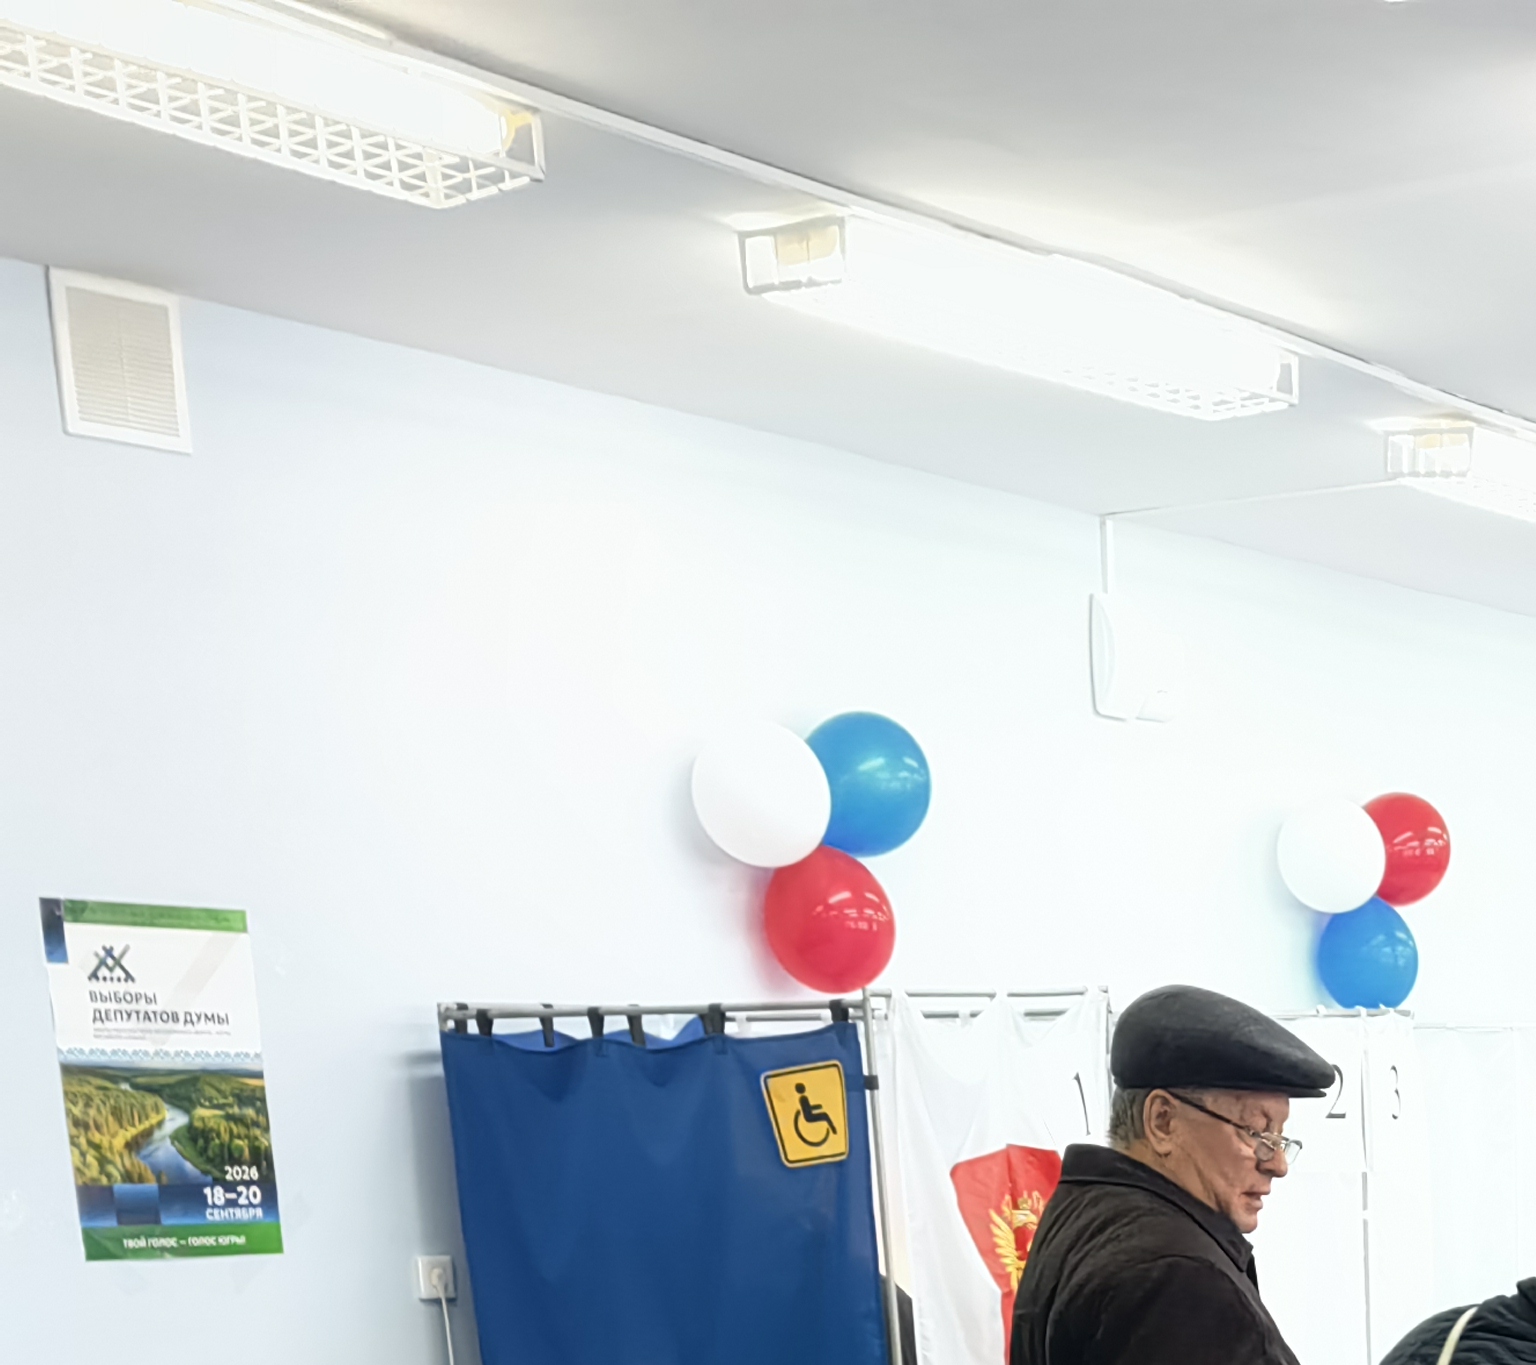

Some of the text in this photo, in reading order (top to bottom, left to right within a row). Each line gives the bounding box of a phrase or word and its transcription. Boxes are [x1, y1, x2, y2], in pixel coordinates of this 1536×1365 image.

[89, 990, 157, 1005] ВЫБОРЫ
[92, 1008, 230, 1027] ДЕПУТАТОВ ДУМЫ
[1325, 1064, 1346, 1119] 2
[224, 1165, 259, 1181] 2026
[206, 1207, 263, 1221] СЕНТЯБРЯ
